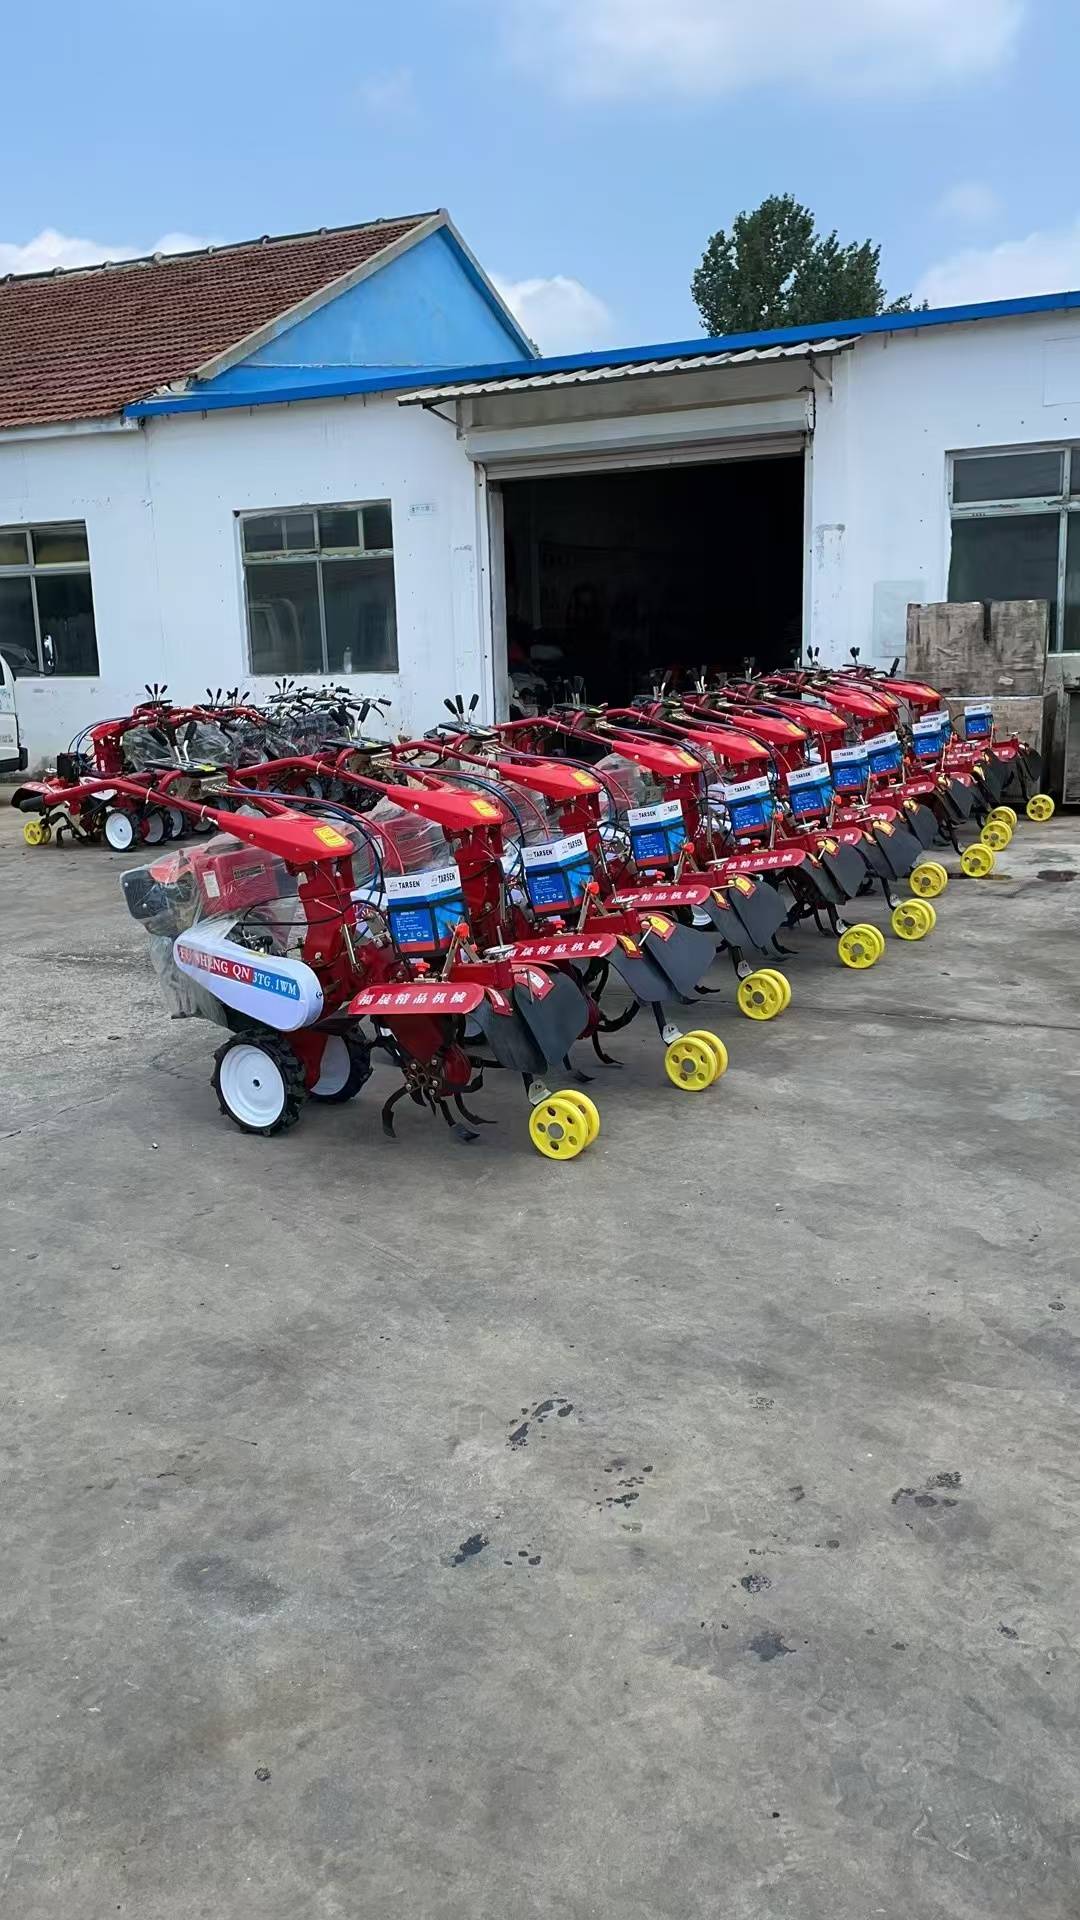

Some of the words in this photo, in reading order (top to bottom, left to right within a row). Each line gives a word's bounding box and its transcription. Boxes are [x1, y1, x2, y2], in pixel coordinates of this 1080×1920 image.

[533, 849, 553, 858] TARSEN
[438, 872, 456, 884] TARSEN
[398, 881, 421, 889] TARSEN
[233, 964, 251, 980] QN
